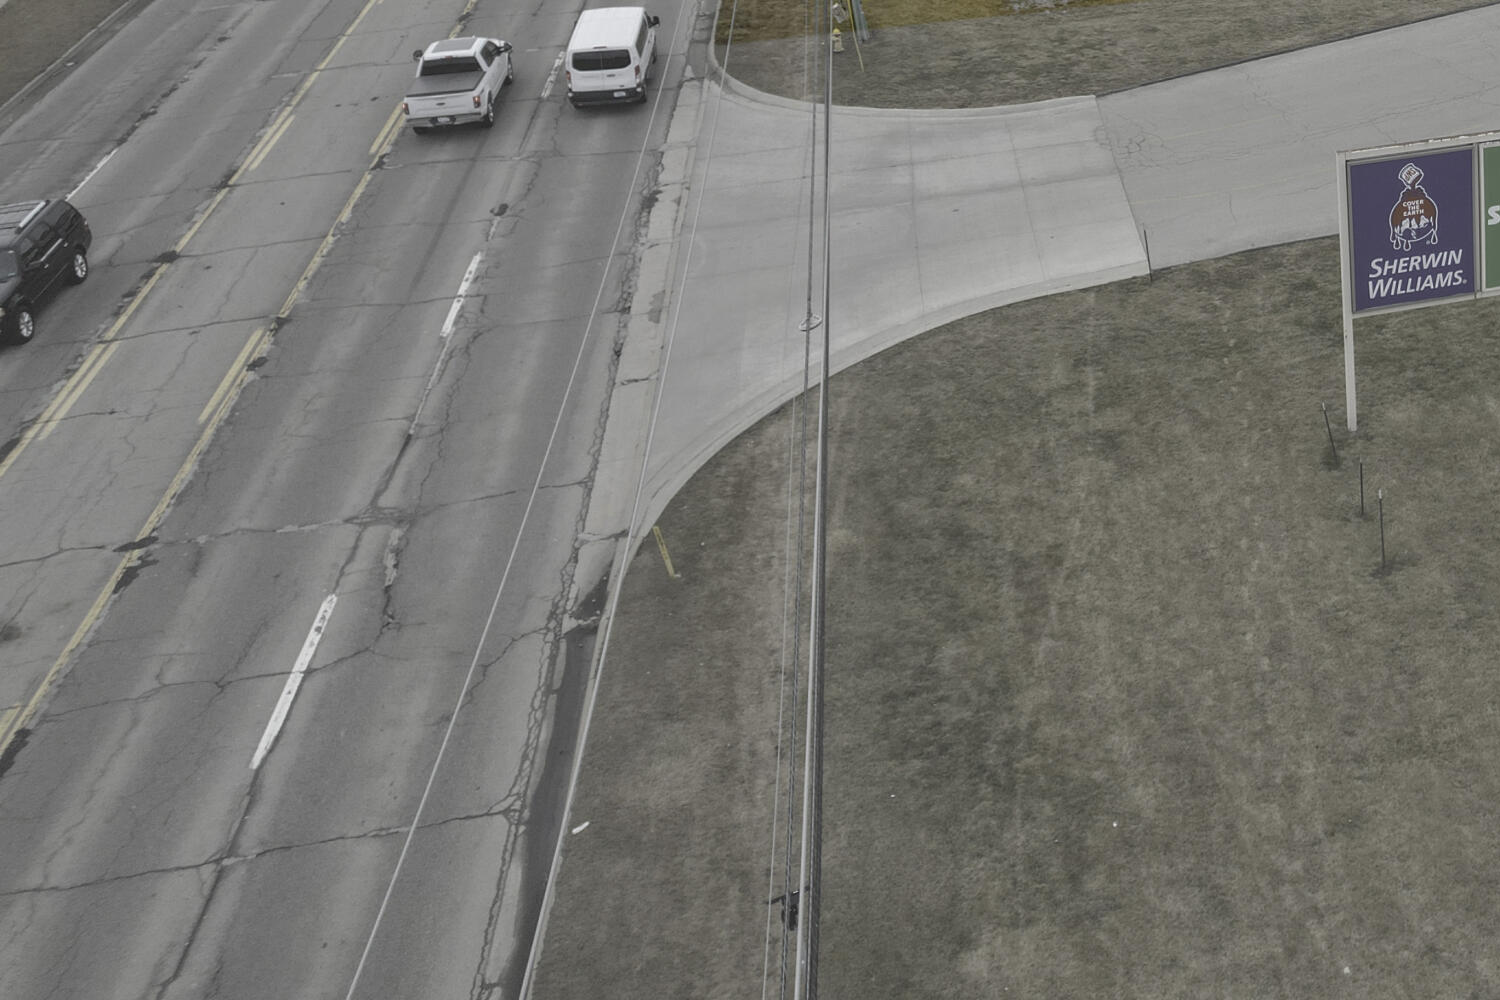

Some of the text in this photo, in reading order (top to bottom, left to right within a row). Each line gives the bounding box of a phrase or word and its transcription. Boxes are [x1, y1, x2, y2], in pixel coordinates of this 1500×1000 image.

[1402, 199, 1425, 207] COVER
[1402, 209, 1425, 217] EARTH
[1368, 249, 1464, 278] SHERWIN
[1367, 270, 1465, 300] WILLIAMS
